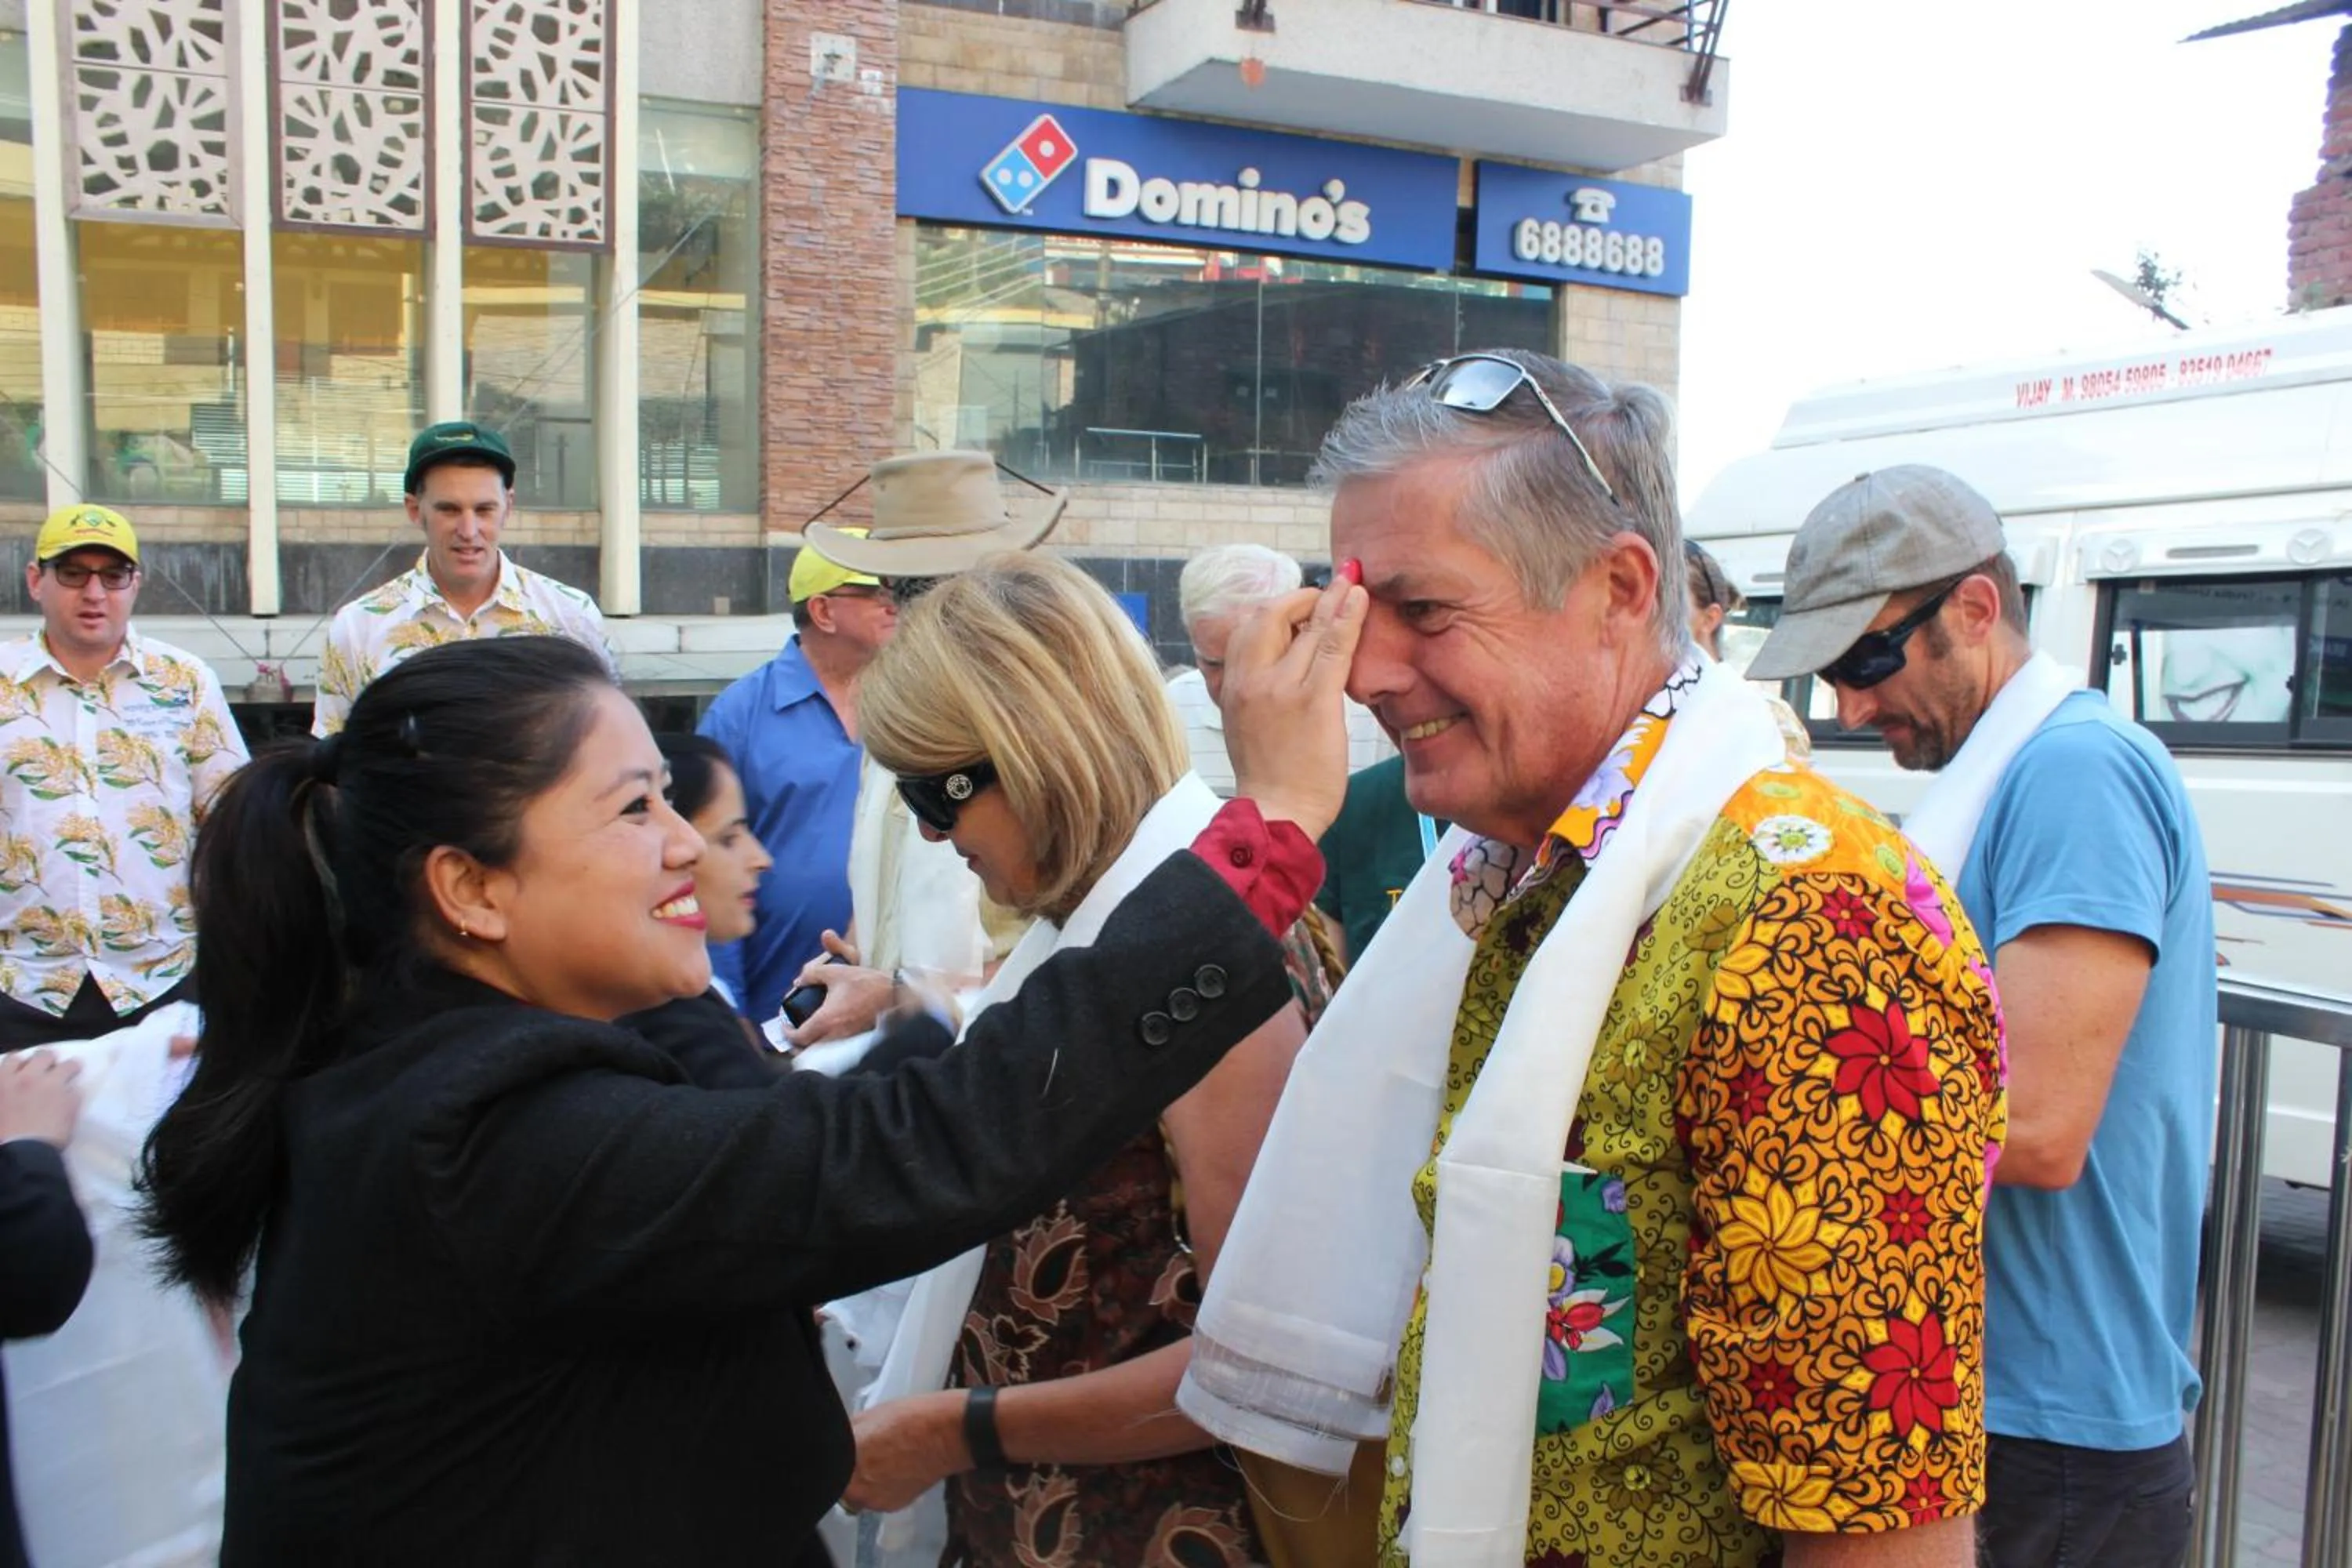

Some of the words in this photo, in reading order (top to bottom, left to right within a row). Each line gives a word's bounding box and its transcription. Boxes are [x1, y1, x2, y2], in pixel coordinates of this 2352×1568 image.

[1083, 157, 1370, 244] Domino's
[1515, 217, 1664, 277] 6888688
[2016, 379, 2052, 408] VIJAY
